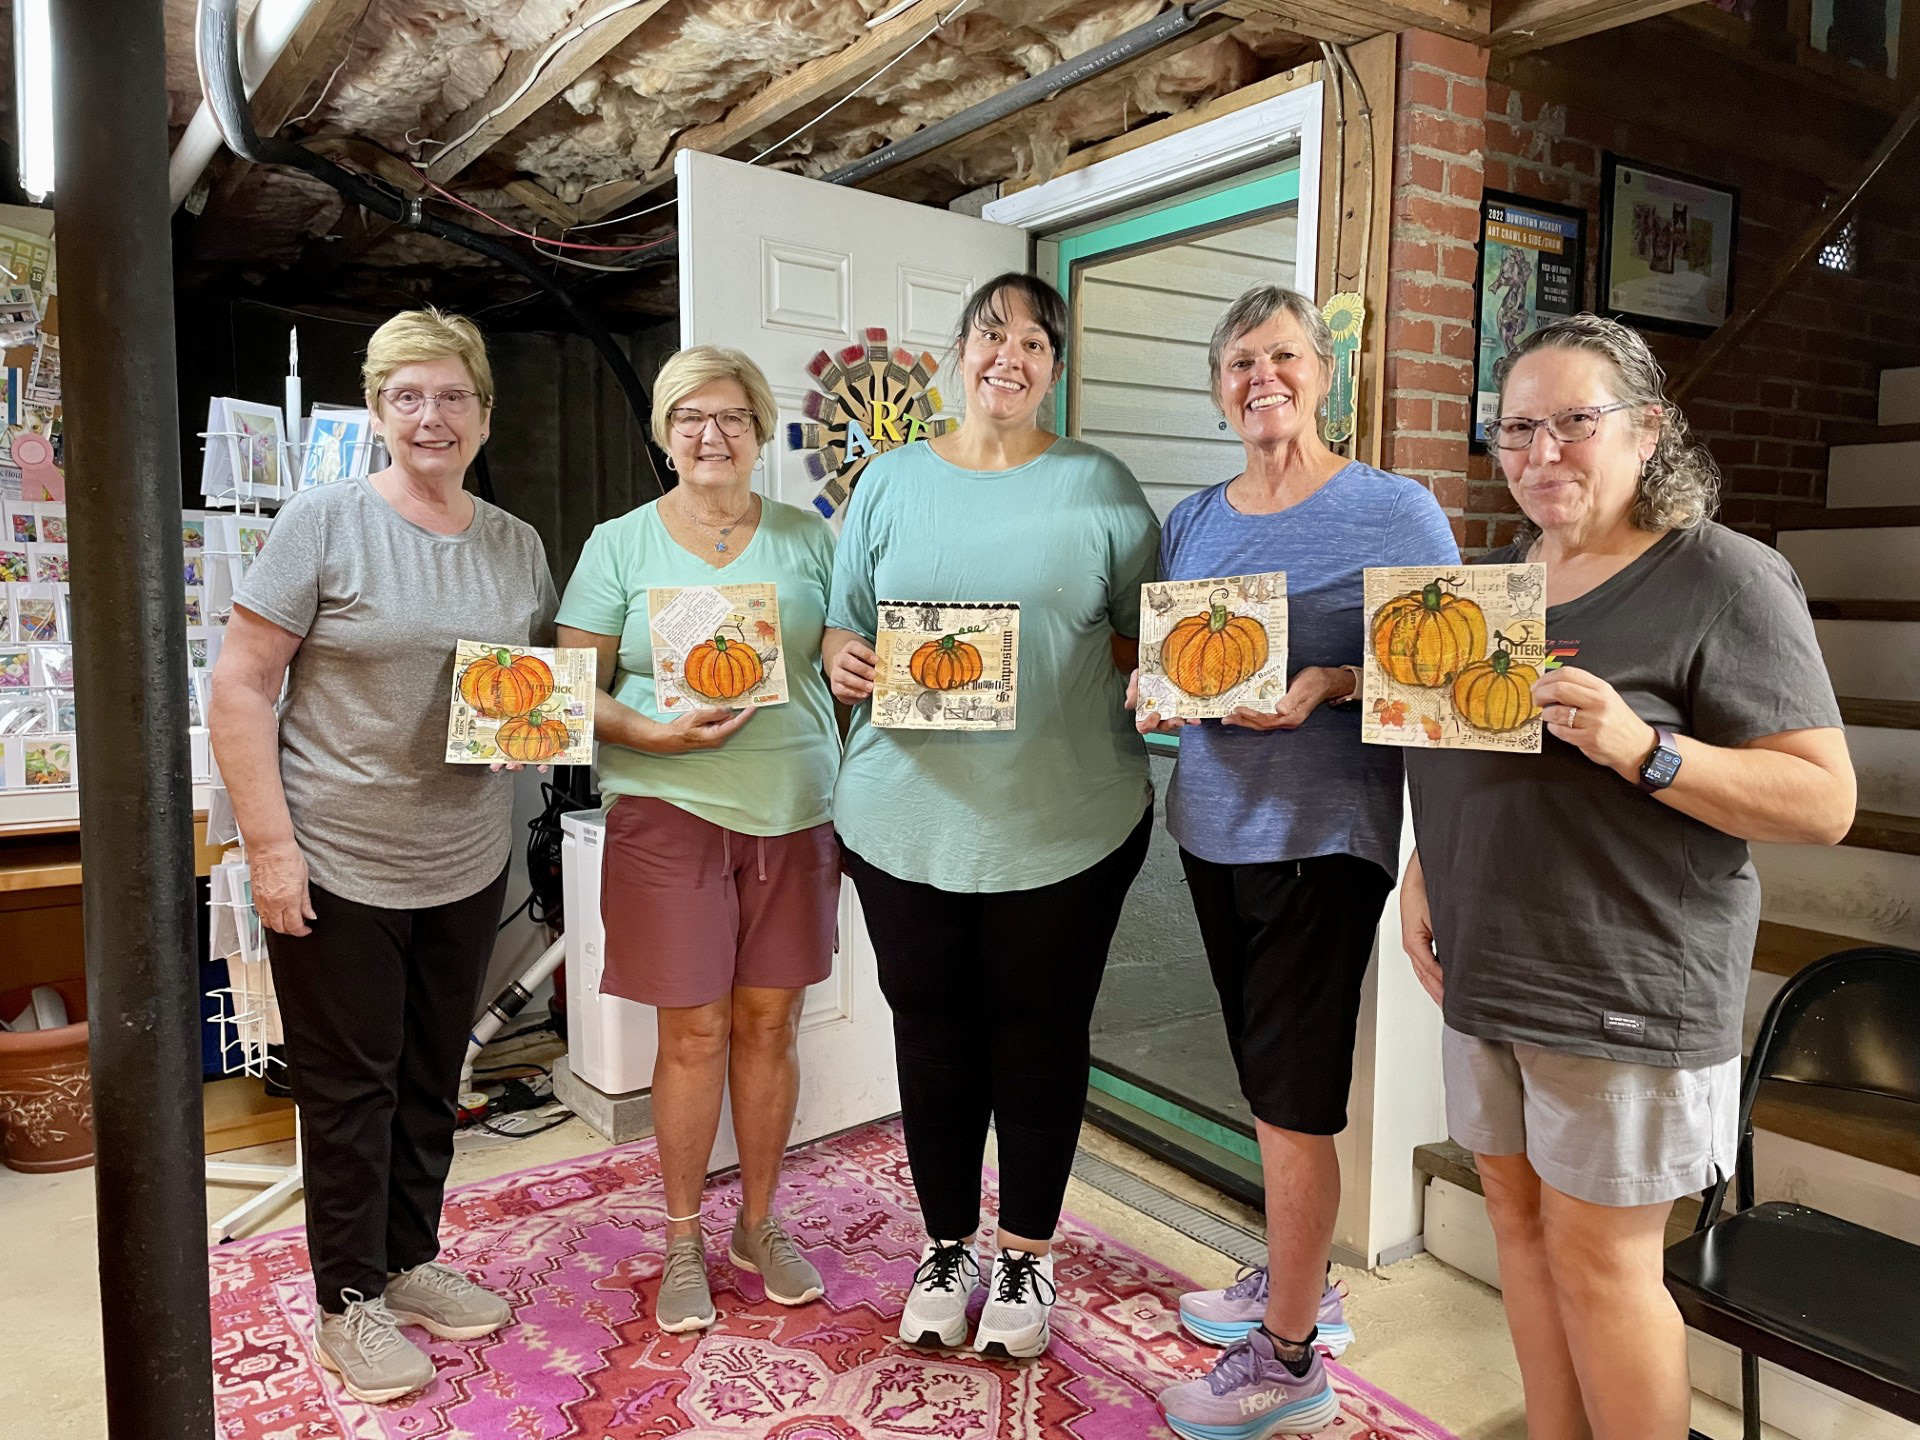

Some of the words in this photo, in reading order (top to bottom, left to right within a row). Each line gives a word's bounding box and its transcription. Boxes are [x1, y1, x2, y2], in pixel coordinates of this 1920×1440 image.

[1488, 208, 1504, 221] 2022
[1506, 213, 1538, 228] DOWNTOWN
[1488, 226, 1499, 237] ART
[1502, 229, 1521, 242] CRAWL
[32, 272, 42, 282] 19
[844, 400, 929, 464] ART
[996, 630, 1014, 702] Symposium
[1238, 1387, 1288, 1416] HOKA
